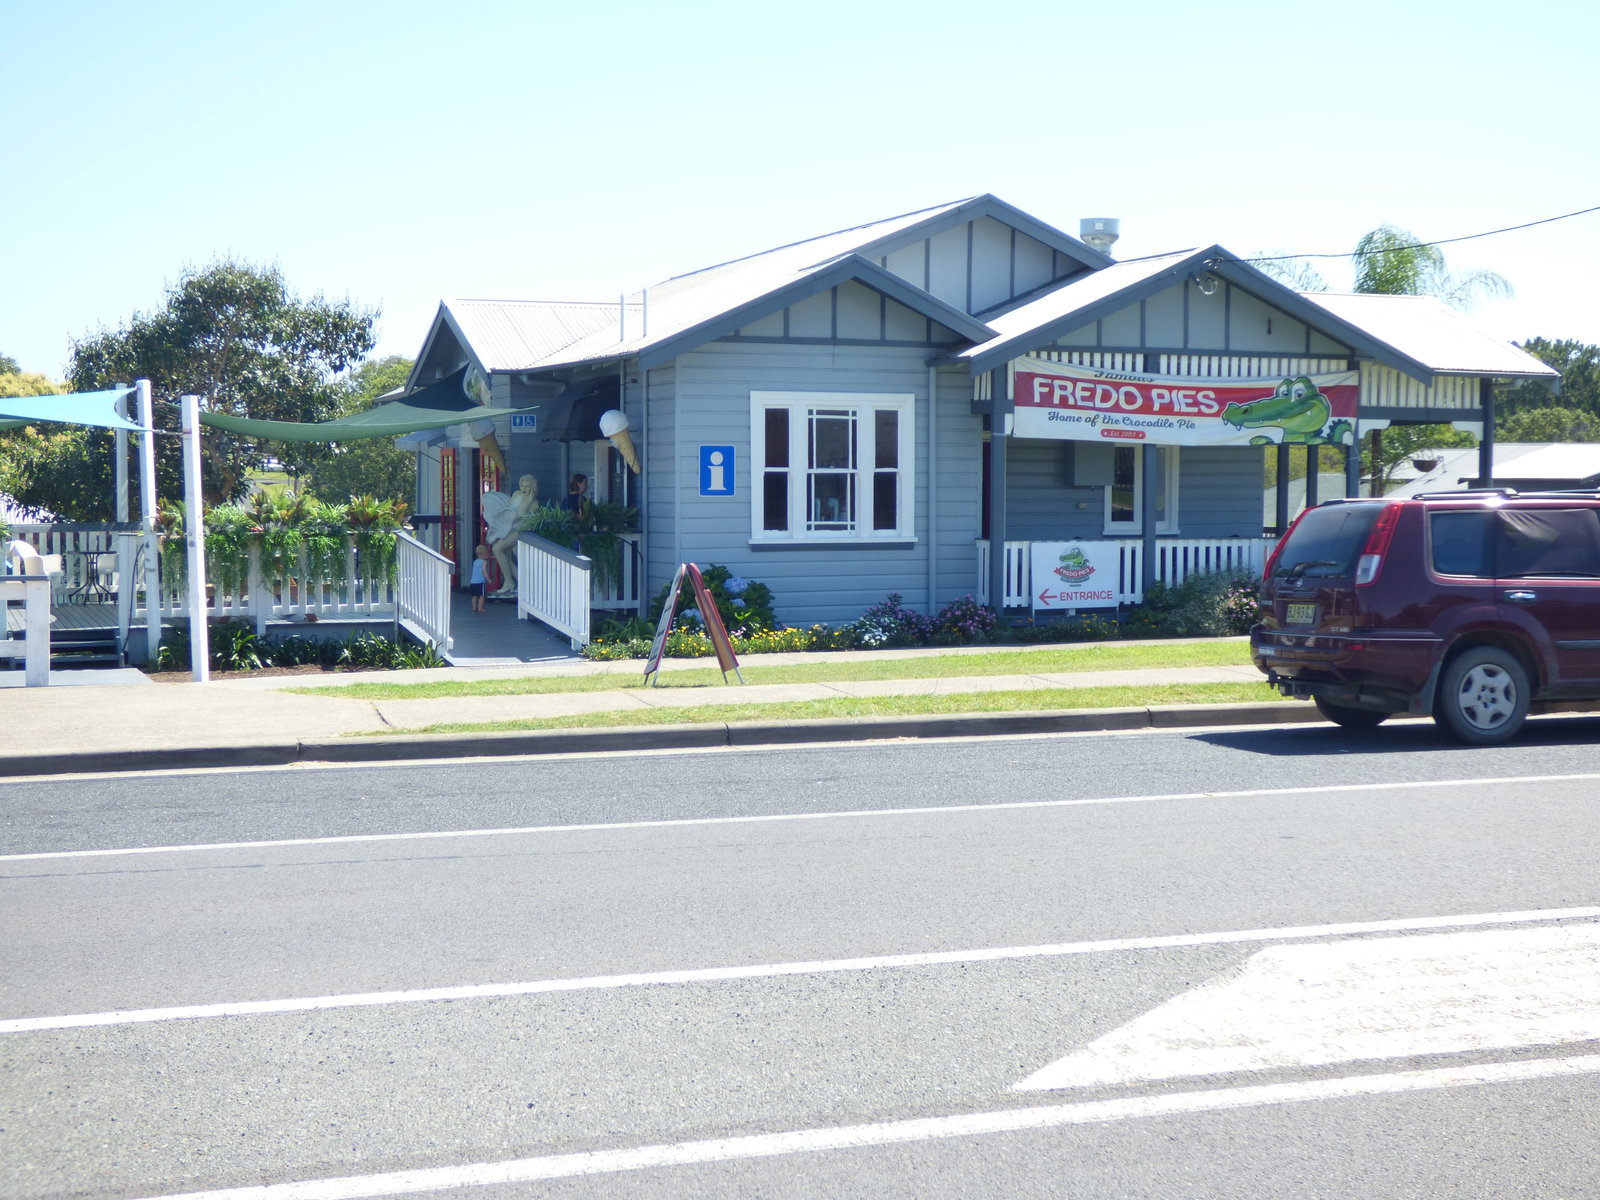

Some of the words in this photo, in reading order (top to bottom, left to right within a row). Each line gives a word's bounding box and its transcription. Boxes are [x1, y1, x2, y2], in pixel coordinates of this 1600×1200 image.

[1033, 376, 1144, 411] FREDO
[1151, 387, 1220, 414] PIES
[1048, 411, 1083, 424] Home
[1084, 414, 1100, 428] of
[1102, 414, 1121, 426] the
[1121, 416, 1175, 429] Crocodile
[1176, 418, 1197, 430] Pie
[1059, 590, 1113, 601] ENTRANCE
